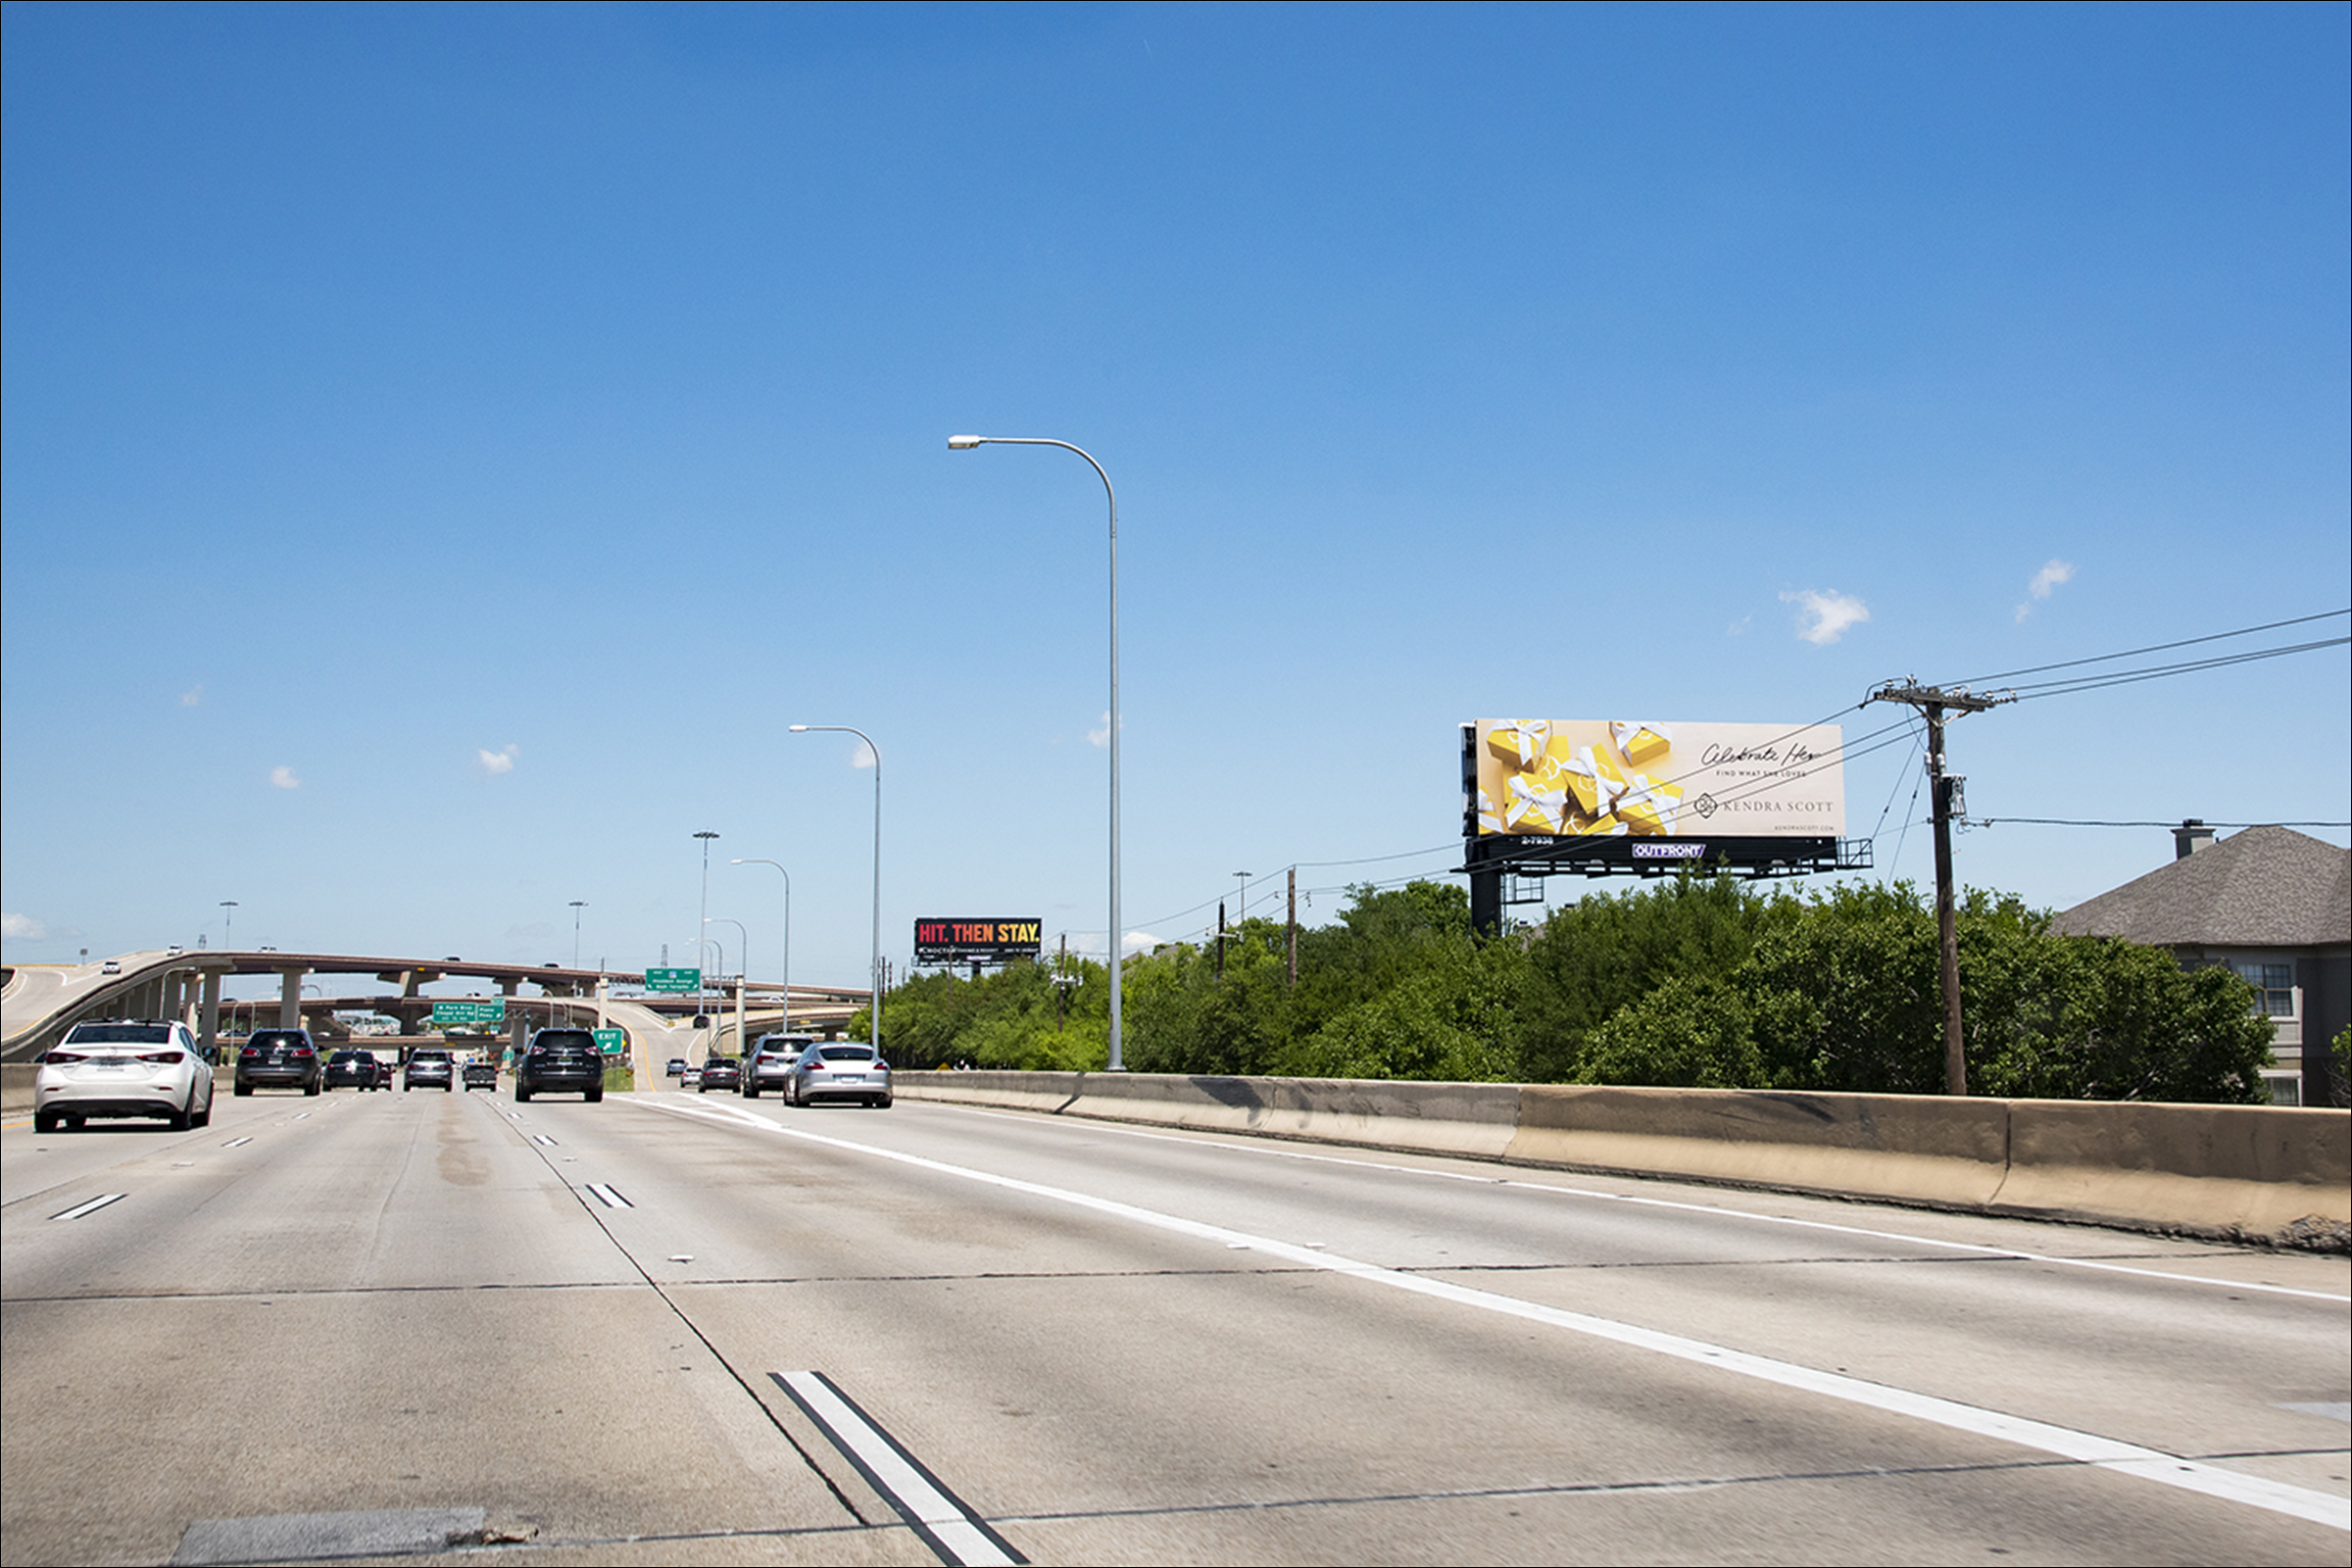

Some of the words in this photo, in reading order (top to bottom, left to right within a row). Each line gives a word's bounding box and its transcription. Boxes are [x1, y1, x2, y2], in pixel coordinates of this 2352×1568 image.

[1701, 743, 1779, 765] Celebrate
[1781, 743, 1821, 766] Her
[1724, 802, 1782, 811] KENDRA
[1787, 802, 1834, 811] SCOTT
[1634, 845, 1703, 858] OUTFRONT
[919, 924, 949, 943] HIT.
[952, 924, 994, 943] THEN
[998, 924, 1040, 943] STAY.
